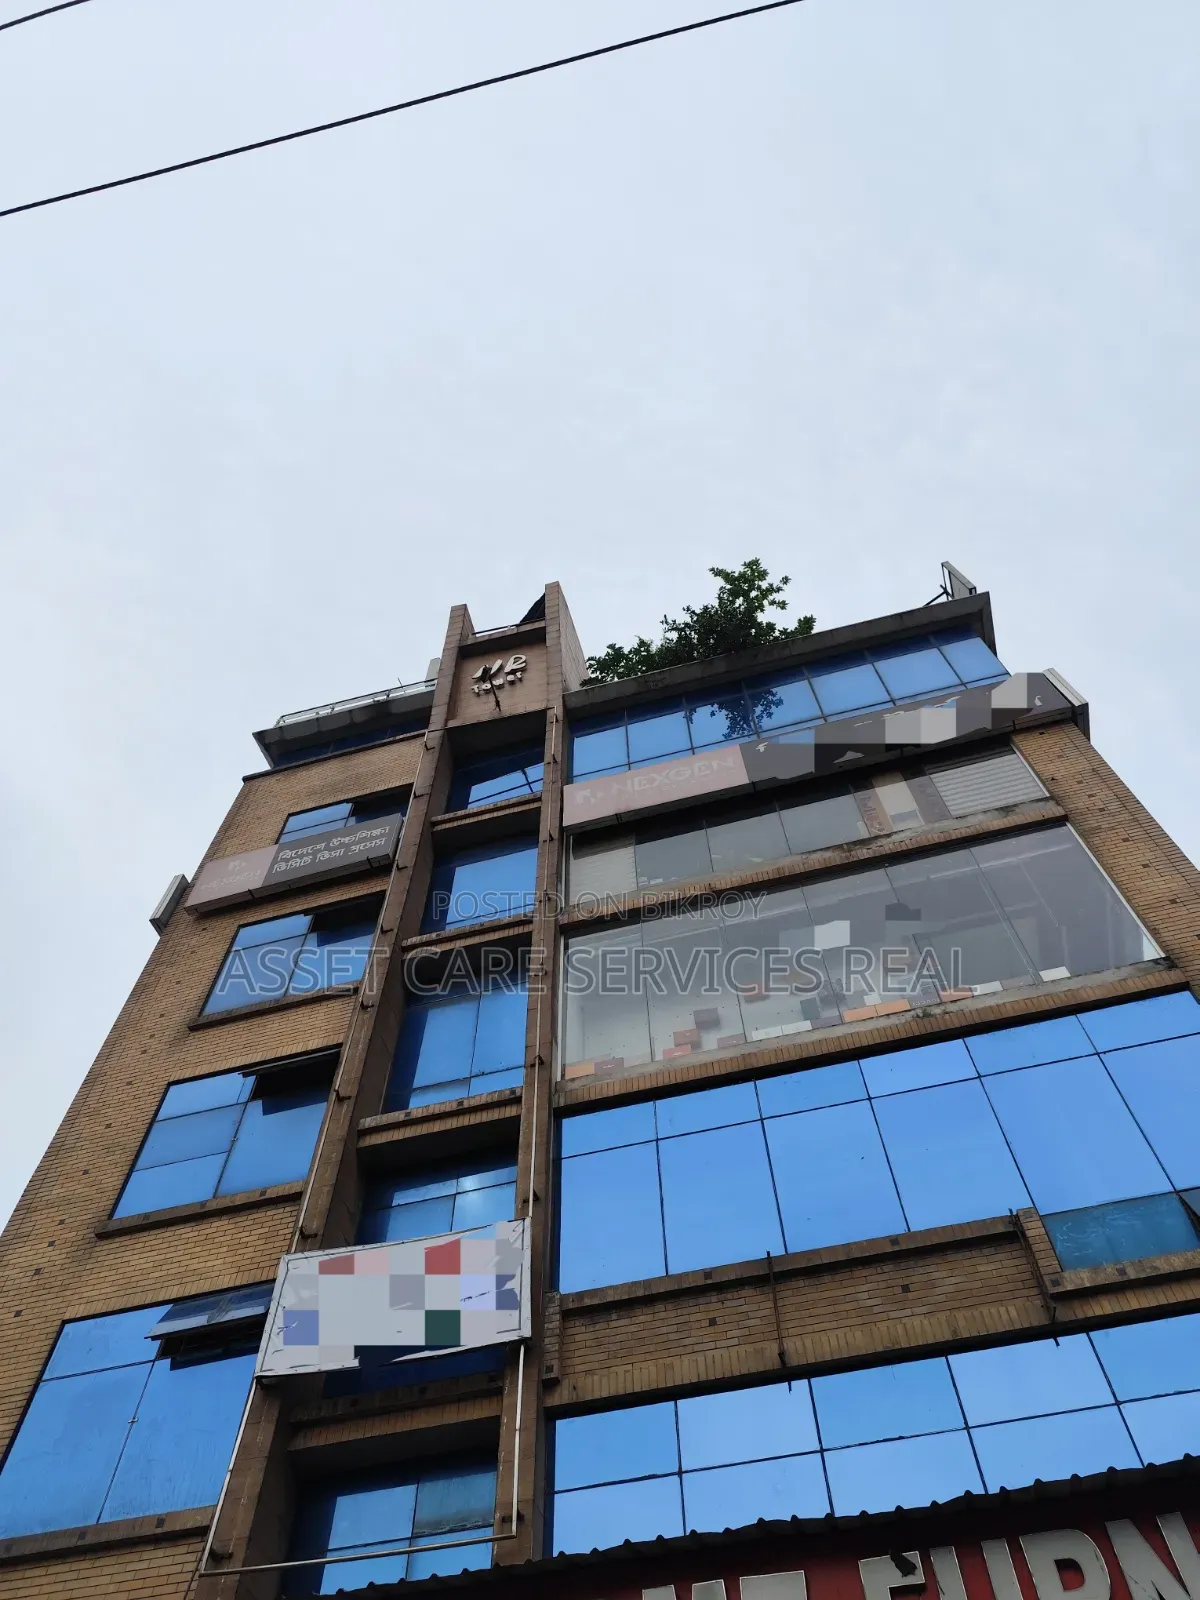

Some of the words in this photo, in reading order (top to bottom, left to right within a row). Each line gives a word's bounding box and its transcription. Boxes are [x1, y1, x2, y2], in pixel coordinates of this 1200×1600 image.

[611, 757, 735, 794] NEXGEN
[278, 842, 327, 860] বিদেশে
[316, 848, 345, 862] ভিসা
